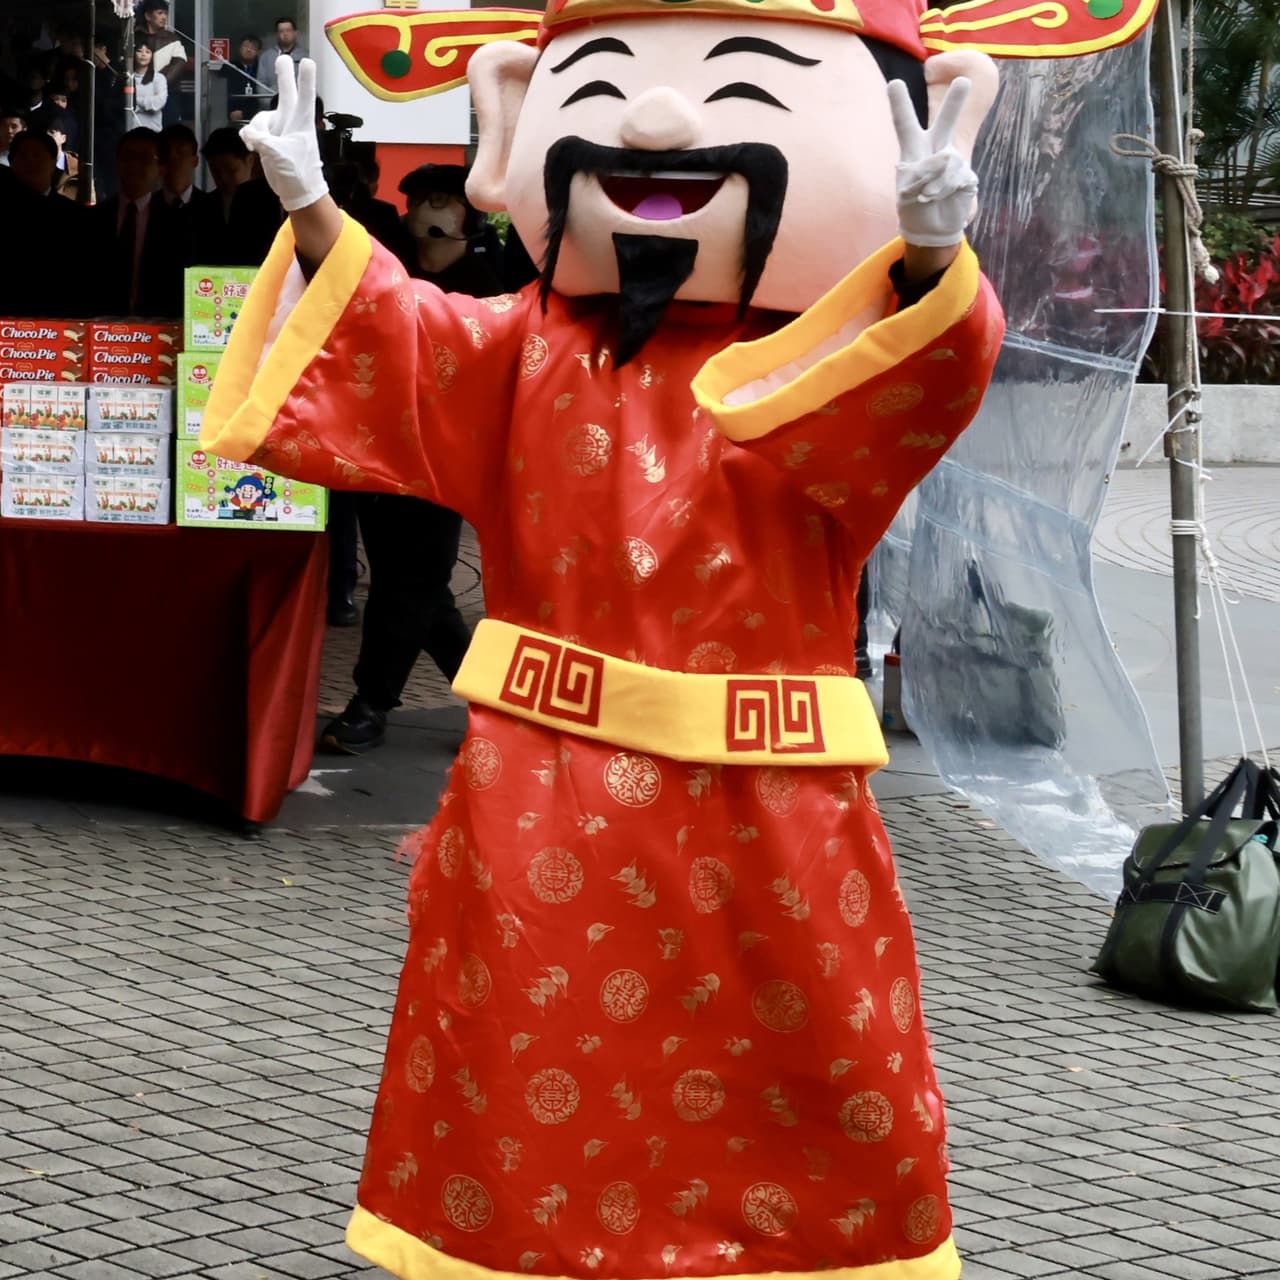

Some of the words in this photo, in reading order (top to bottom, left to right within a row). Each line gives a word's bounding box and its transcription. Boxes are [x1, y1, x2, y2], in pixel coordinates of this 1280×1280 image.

[1, 327, 37, 338] Choco
[37, 328, 58, 339] Pie
[94, 330, 131, 342] Choco
[131, 331, 152, 343] Pie
[0, 347, 36, 359] Choco
[36, 348, 57, 360] Pie
[94, 351, 131, 363] Choco
[131, 352, 152, 364] Pie
[35, 368, 56, 380] Pie
[93, 372, 130, 384] Choco
[130, 373, 152, 385] Pie
